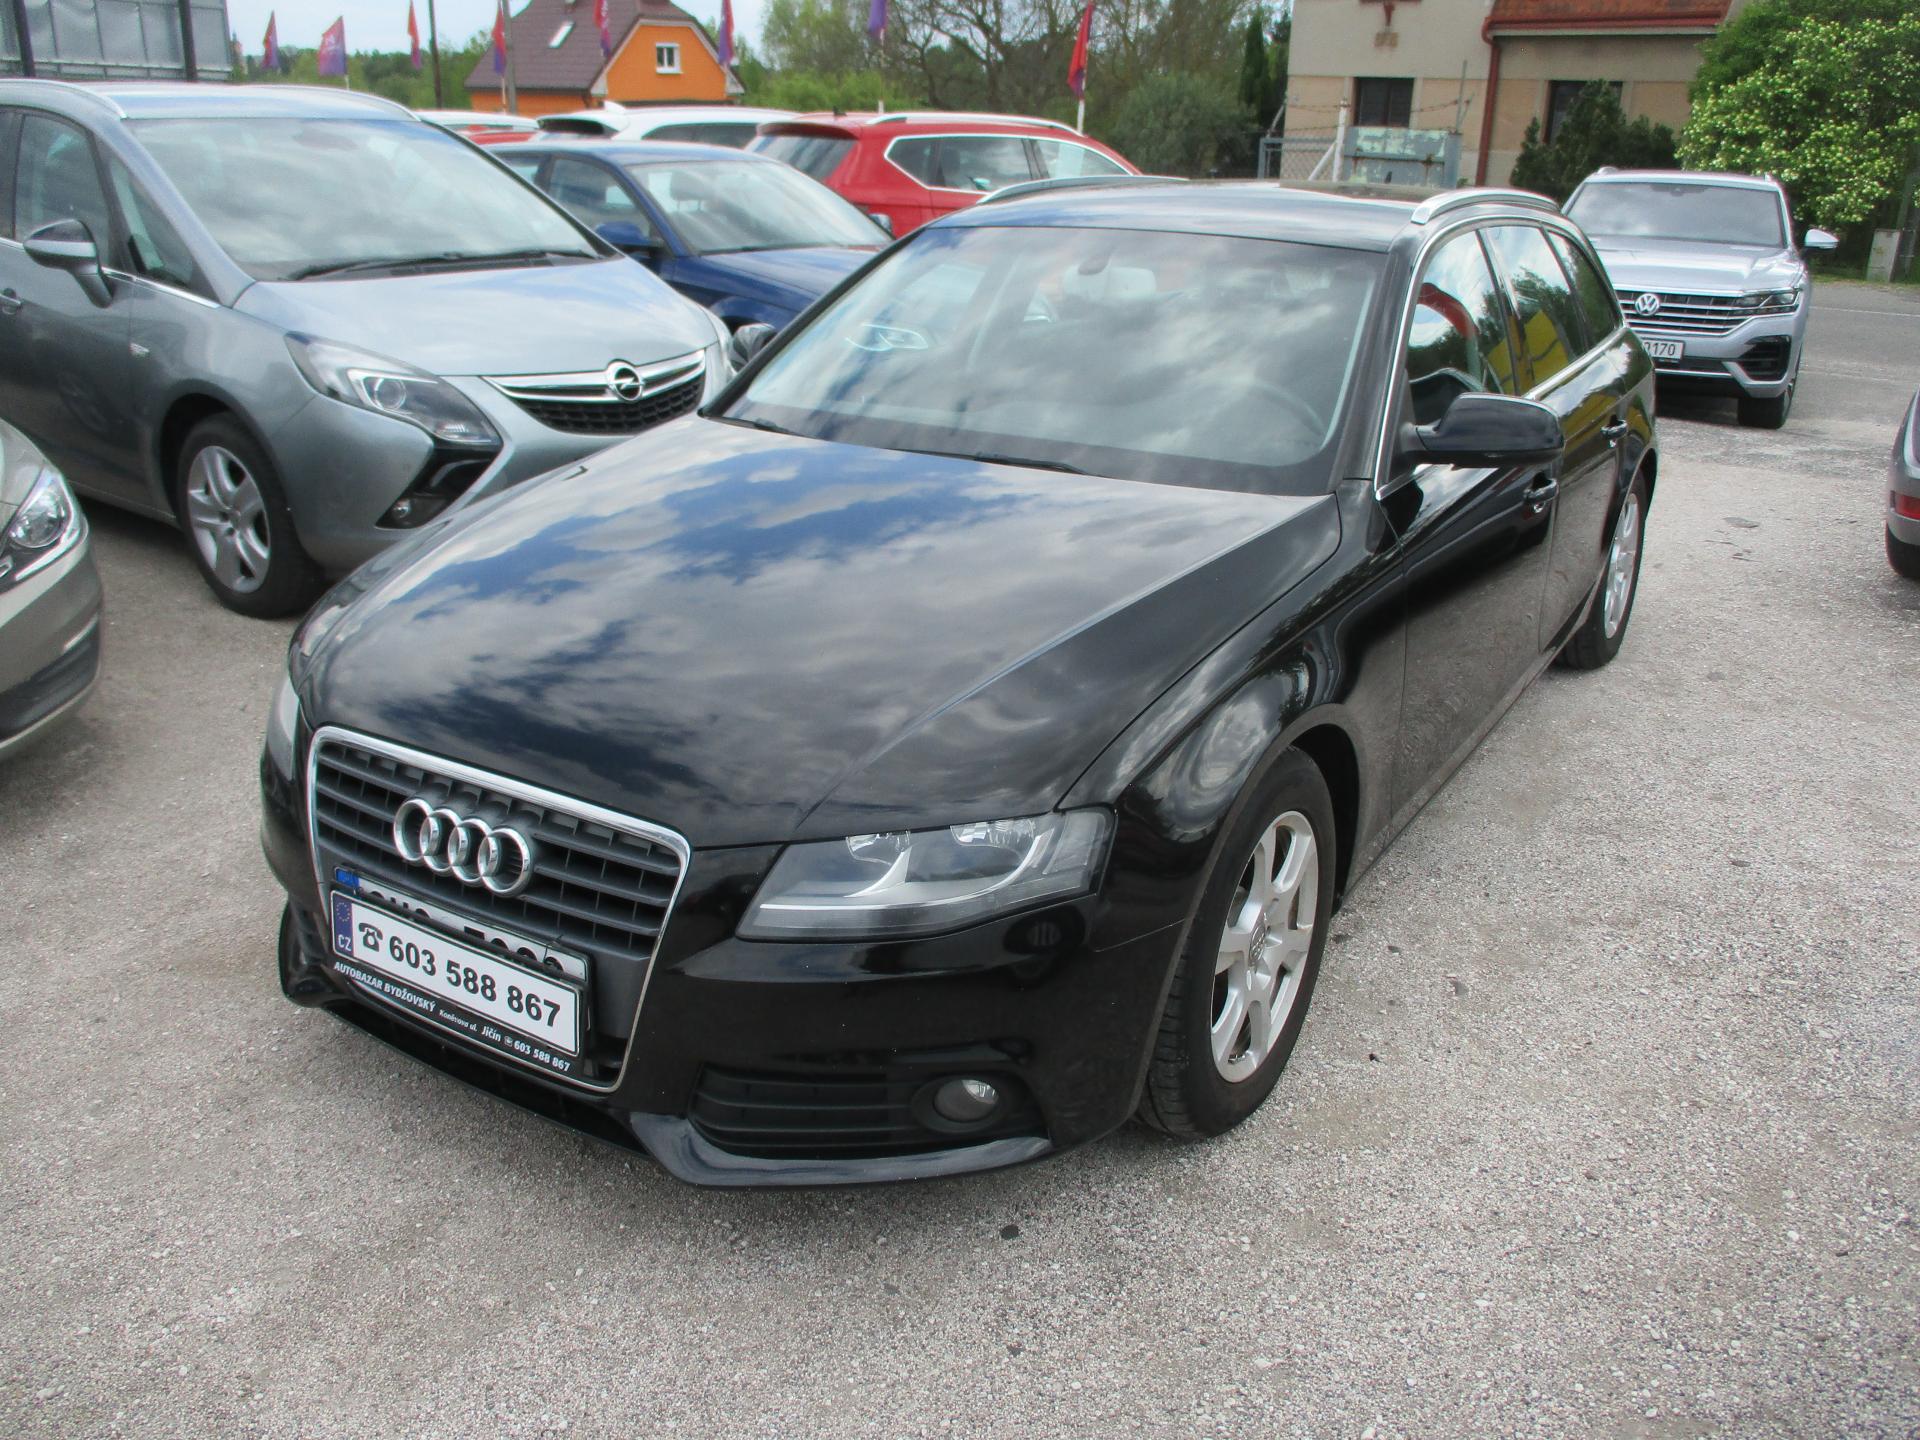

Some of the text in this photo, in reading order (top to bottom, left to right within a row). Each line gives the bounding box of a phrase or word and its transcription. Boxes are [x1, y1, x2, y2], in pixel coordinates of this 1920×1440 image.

[338, 934, 352, 951] CZ
[389, 935, 437, 977] 603
[446, 959, 497, 1002] 588
[507, 985, 561, 1028] 867
[333, 961, 383, 990] AUTOBAZAR
[383, 982, 437, 1013] BYDŽOVSKÝ
[481, 1026, 502, 1042] Jičín
[514, 1040, 531, 1055] 603
[533, 1048, 550, 1064] 588
[552, 1056, 571, 1072] 867
